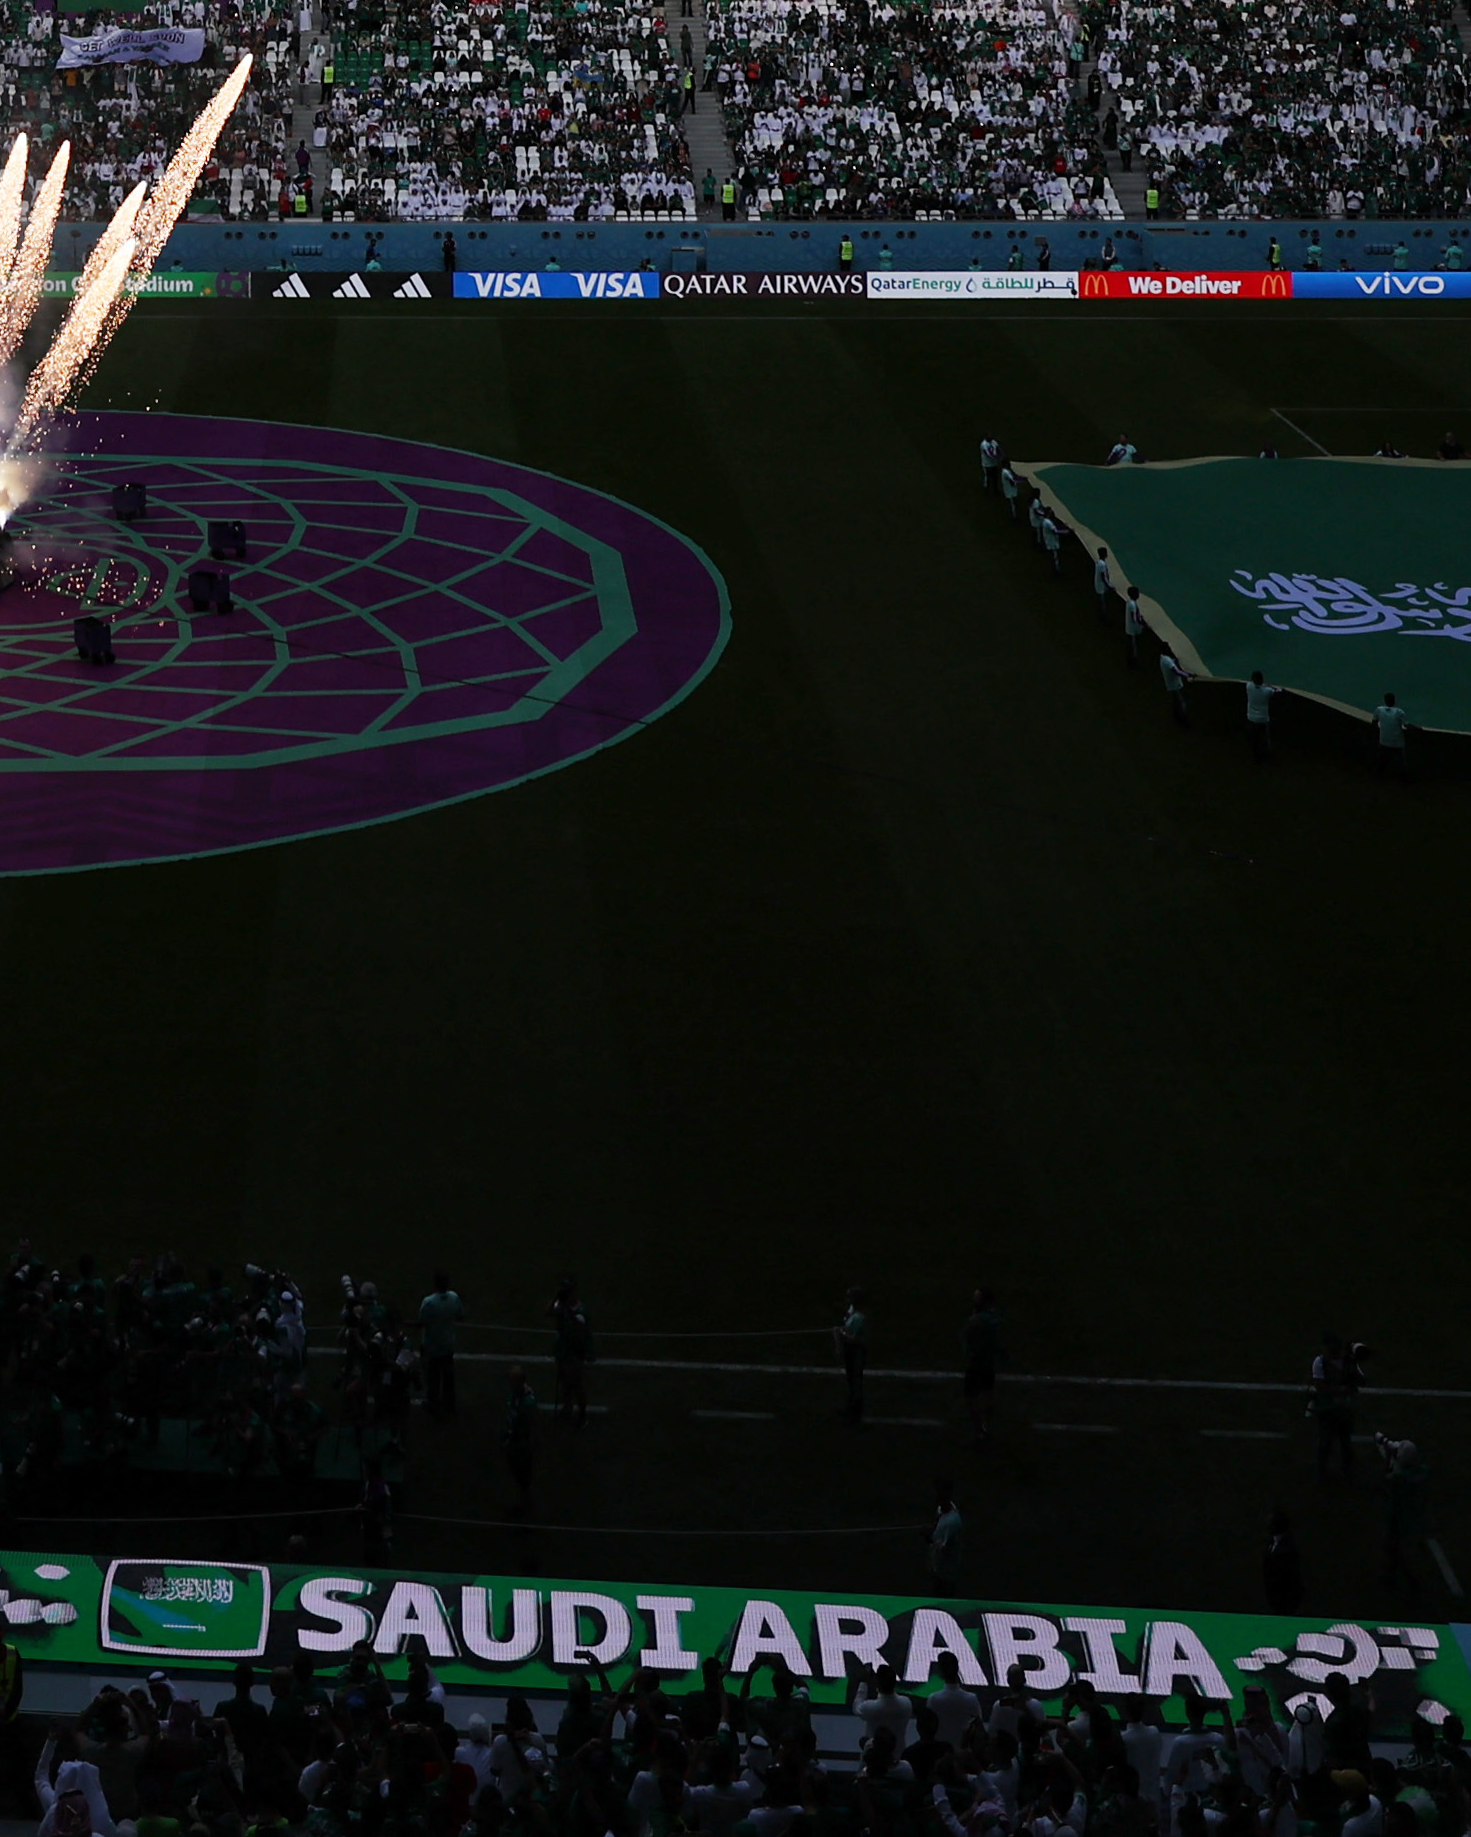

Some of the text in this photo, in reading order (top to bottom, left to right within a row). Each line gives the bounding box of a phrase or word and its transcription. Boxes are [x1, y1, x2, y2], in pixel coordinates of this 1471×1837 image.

[467, 272, 542, 298] VISA
[570, 272, 645, 298] VISA
[663, 274, 863, 299] QATAR AIRWAYS
[870, 277, 962, 292] QatarEnergy
[1128, 274, 1242, 295] We Deliver
[1355, 271, 1446, 295] vivo
[295, 1574, 1236, 1701] SAUDI ARABIA
